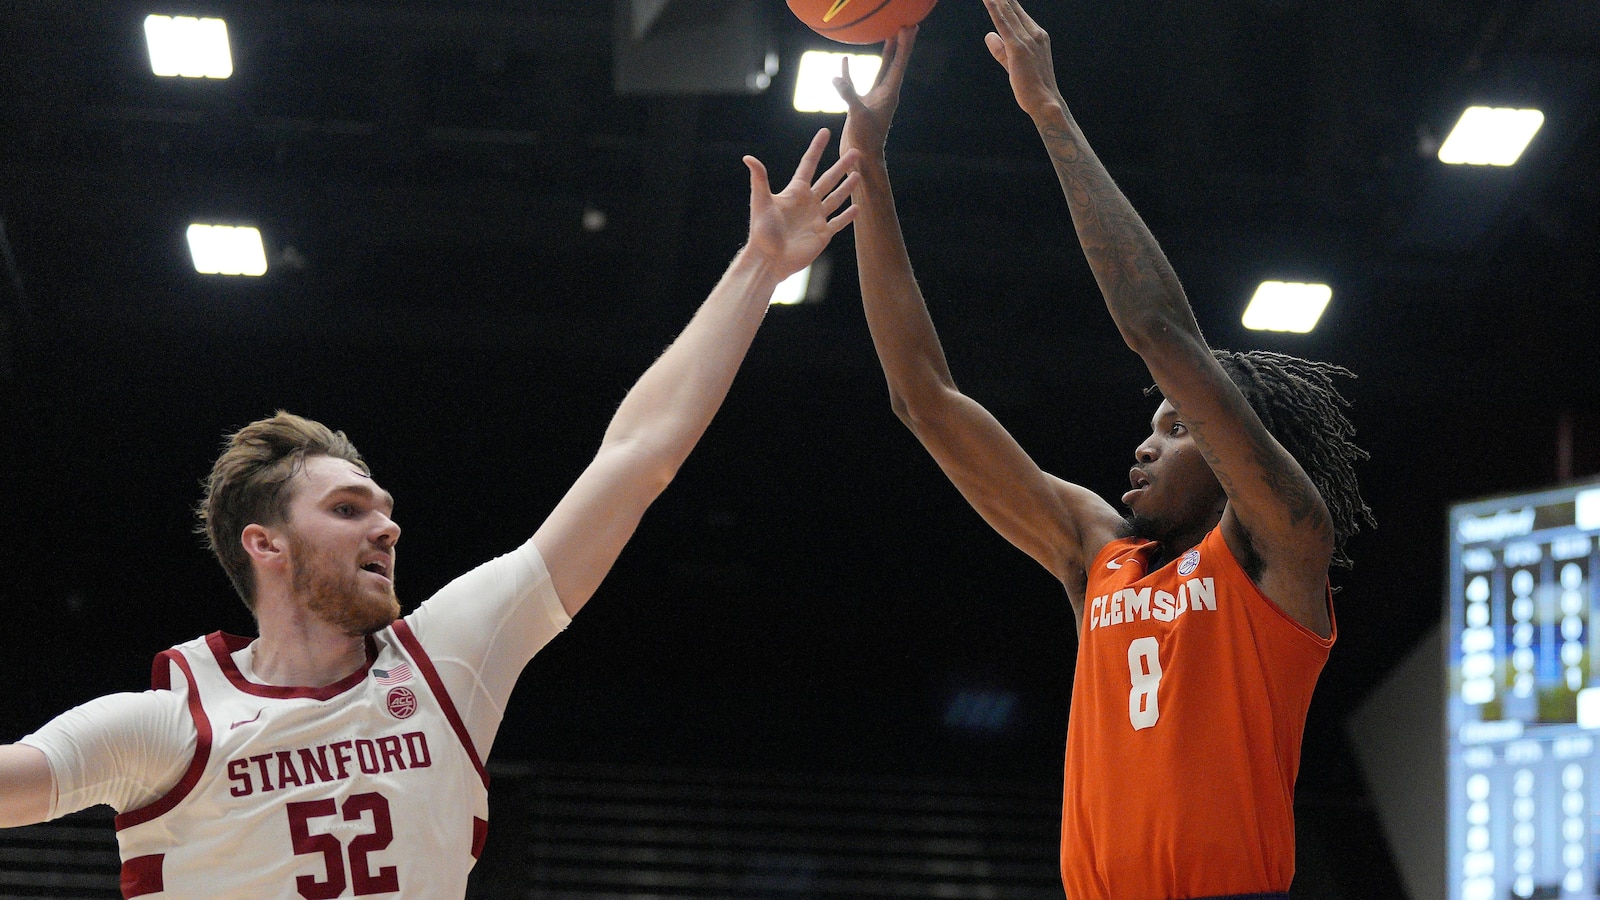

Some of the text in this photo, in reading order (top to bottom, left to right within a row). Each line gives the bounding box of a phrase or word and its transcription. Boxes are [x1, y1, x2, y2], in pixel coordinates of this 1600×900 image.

[1090, 577, 1217, 631] CLEMSON
[390, 695, 413, 706] ACC
[1128, 636, 1163, 731] 8
[227, 731, 432, 798] STANFORD
[286, 791, 400, 900] 52
